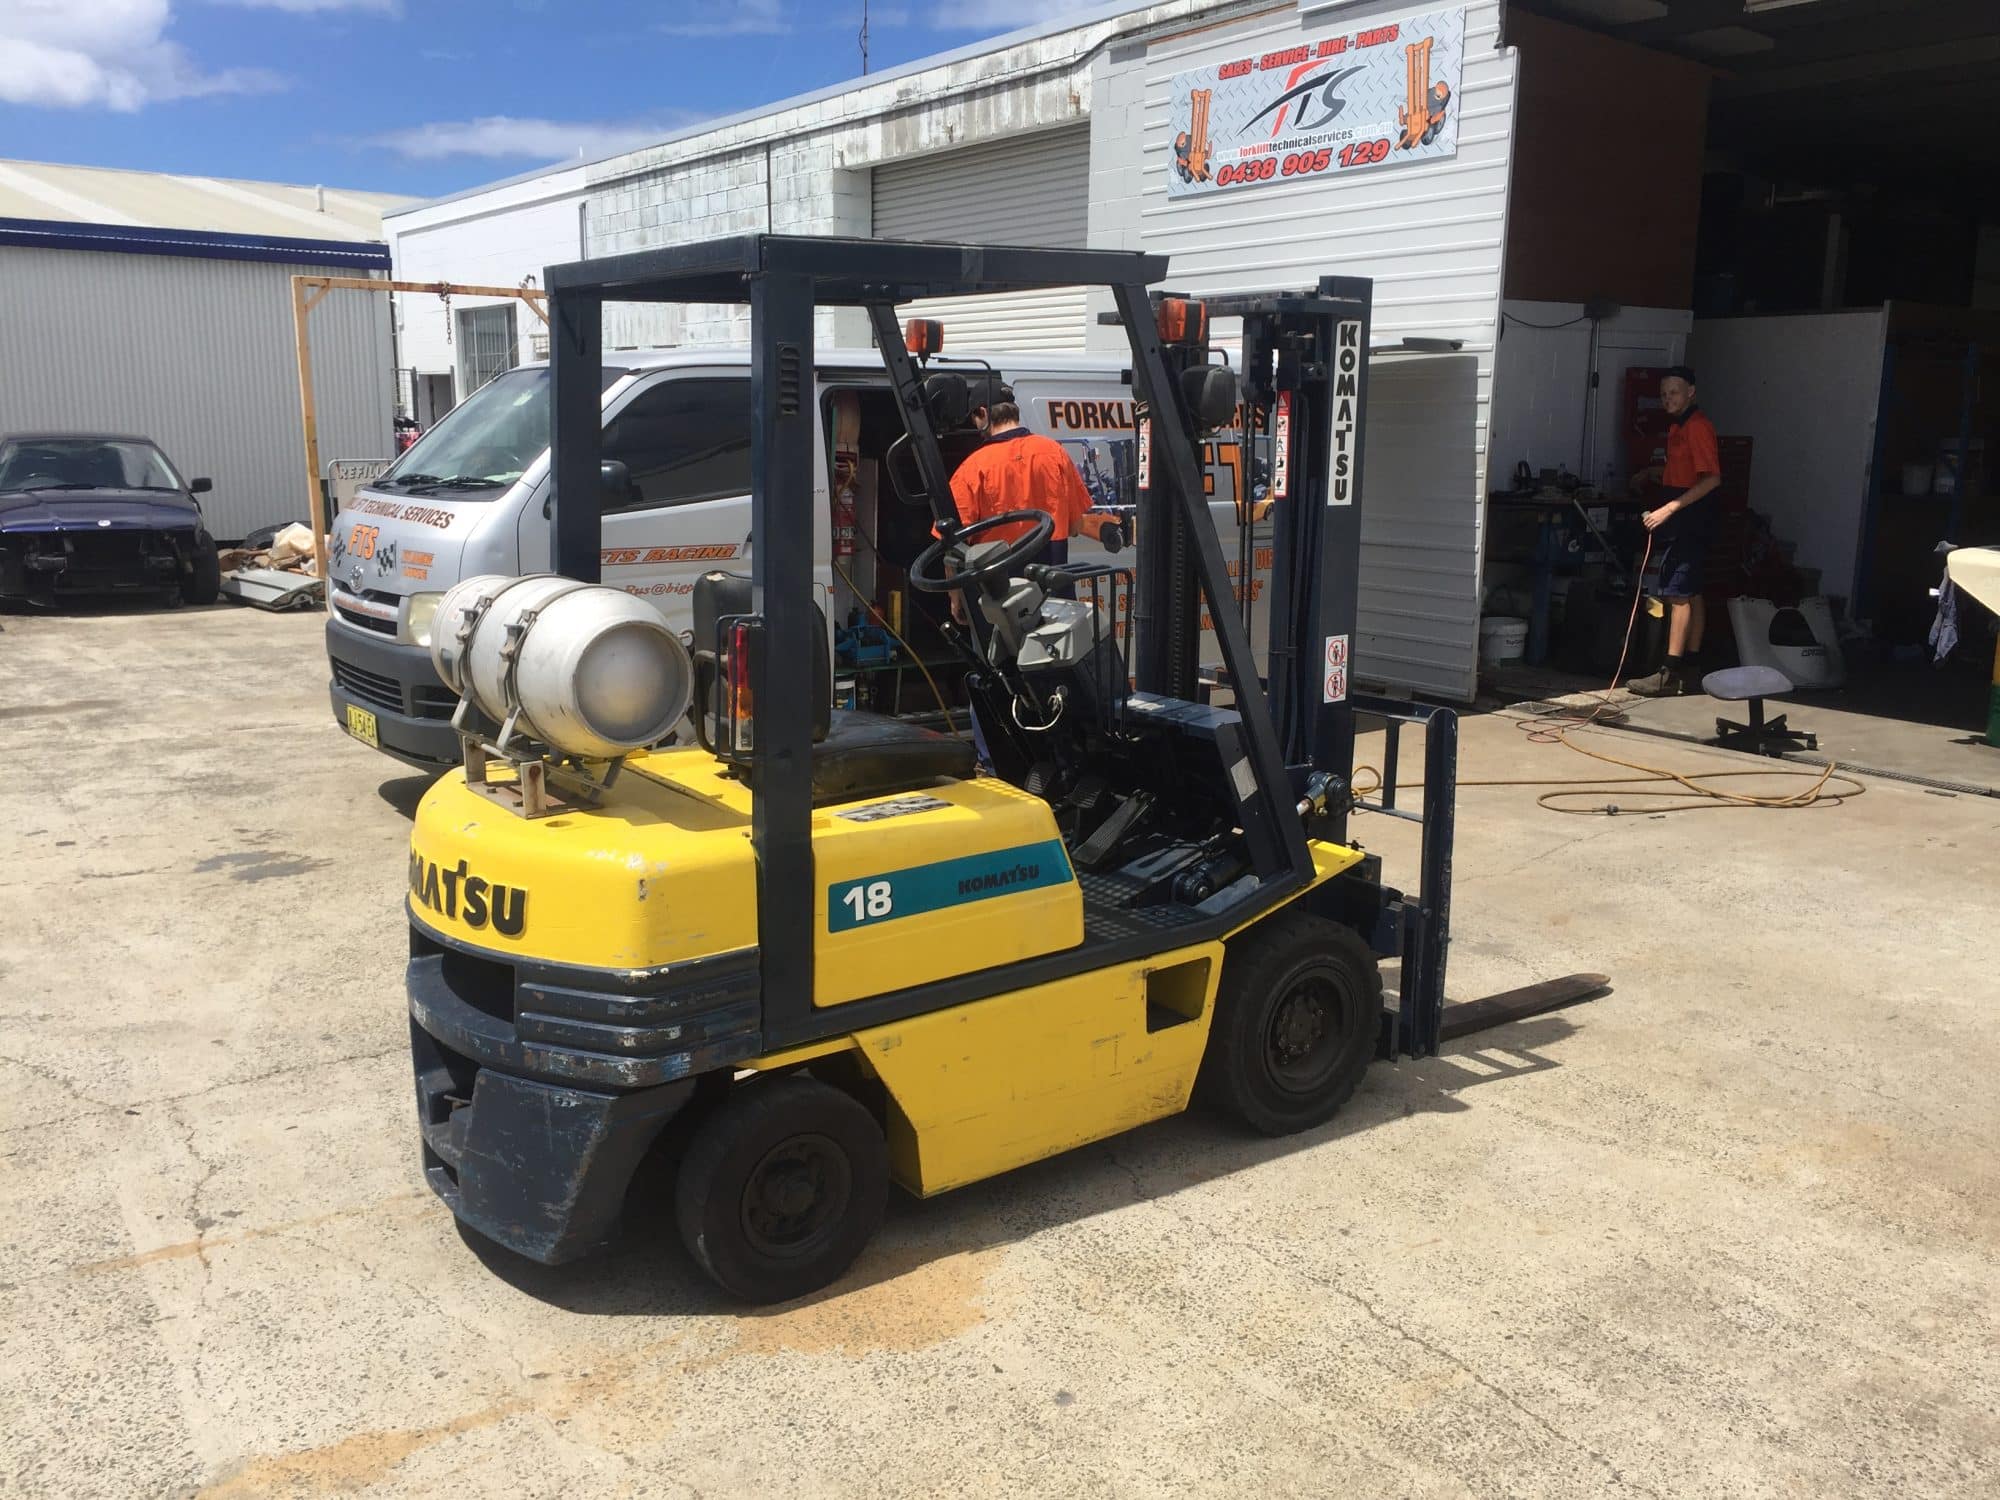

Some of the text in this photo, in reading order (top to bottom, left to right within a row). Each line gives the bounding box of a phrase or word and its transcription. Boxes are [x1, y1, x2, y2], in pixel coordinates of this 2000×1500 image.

[1218, 58, 1254, 80] SALES
[1260, 44, 1311, 71] SERVICE
[1317, 35, 1348, 58] HIRE
[1355, 23, 1399, 49] PARTS
[1216, 138, 1391, 187] 0438 905 129
[1334, 324, 1358, 501] KOMATSU
[400, 505, 455, 529] SERVICES
[347, 523, 380, 560] FTS
[643, 545, 738, 562] RACING
[958, 864, 1040, 897] KOMATSU
[843, 880, 893, 921] 18
